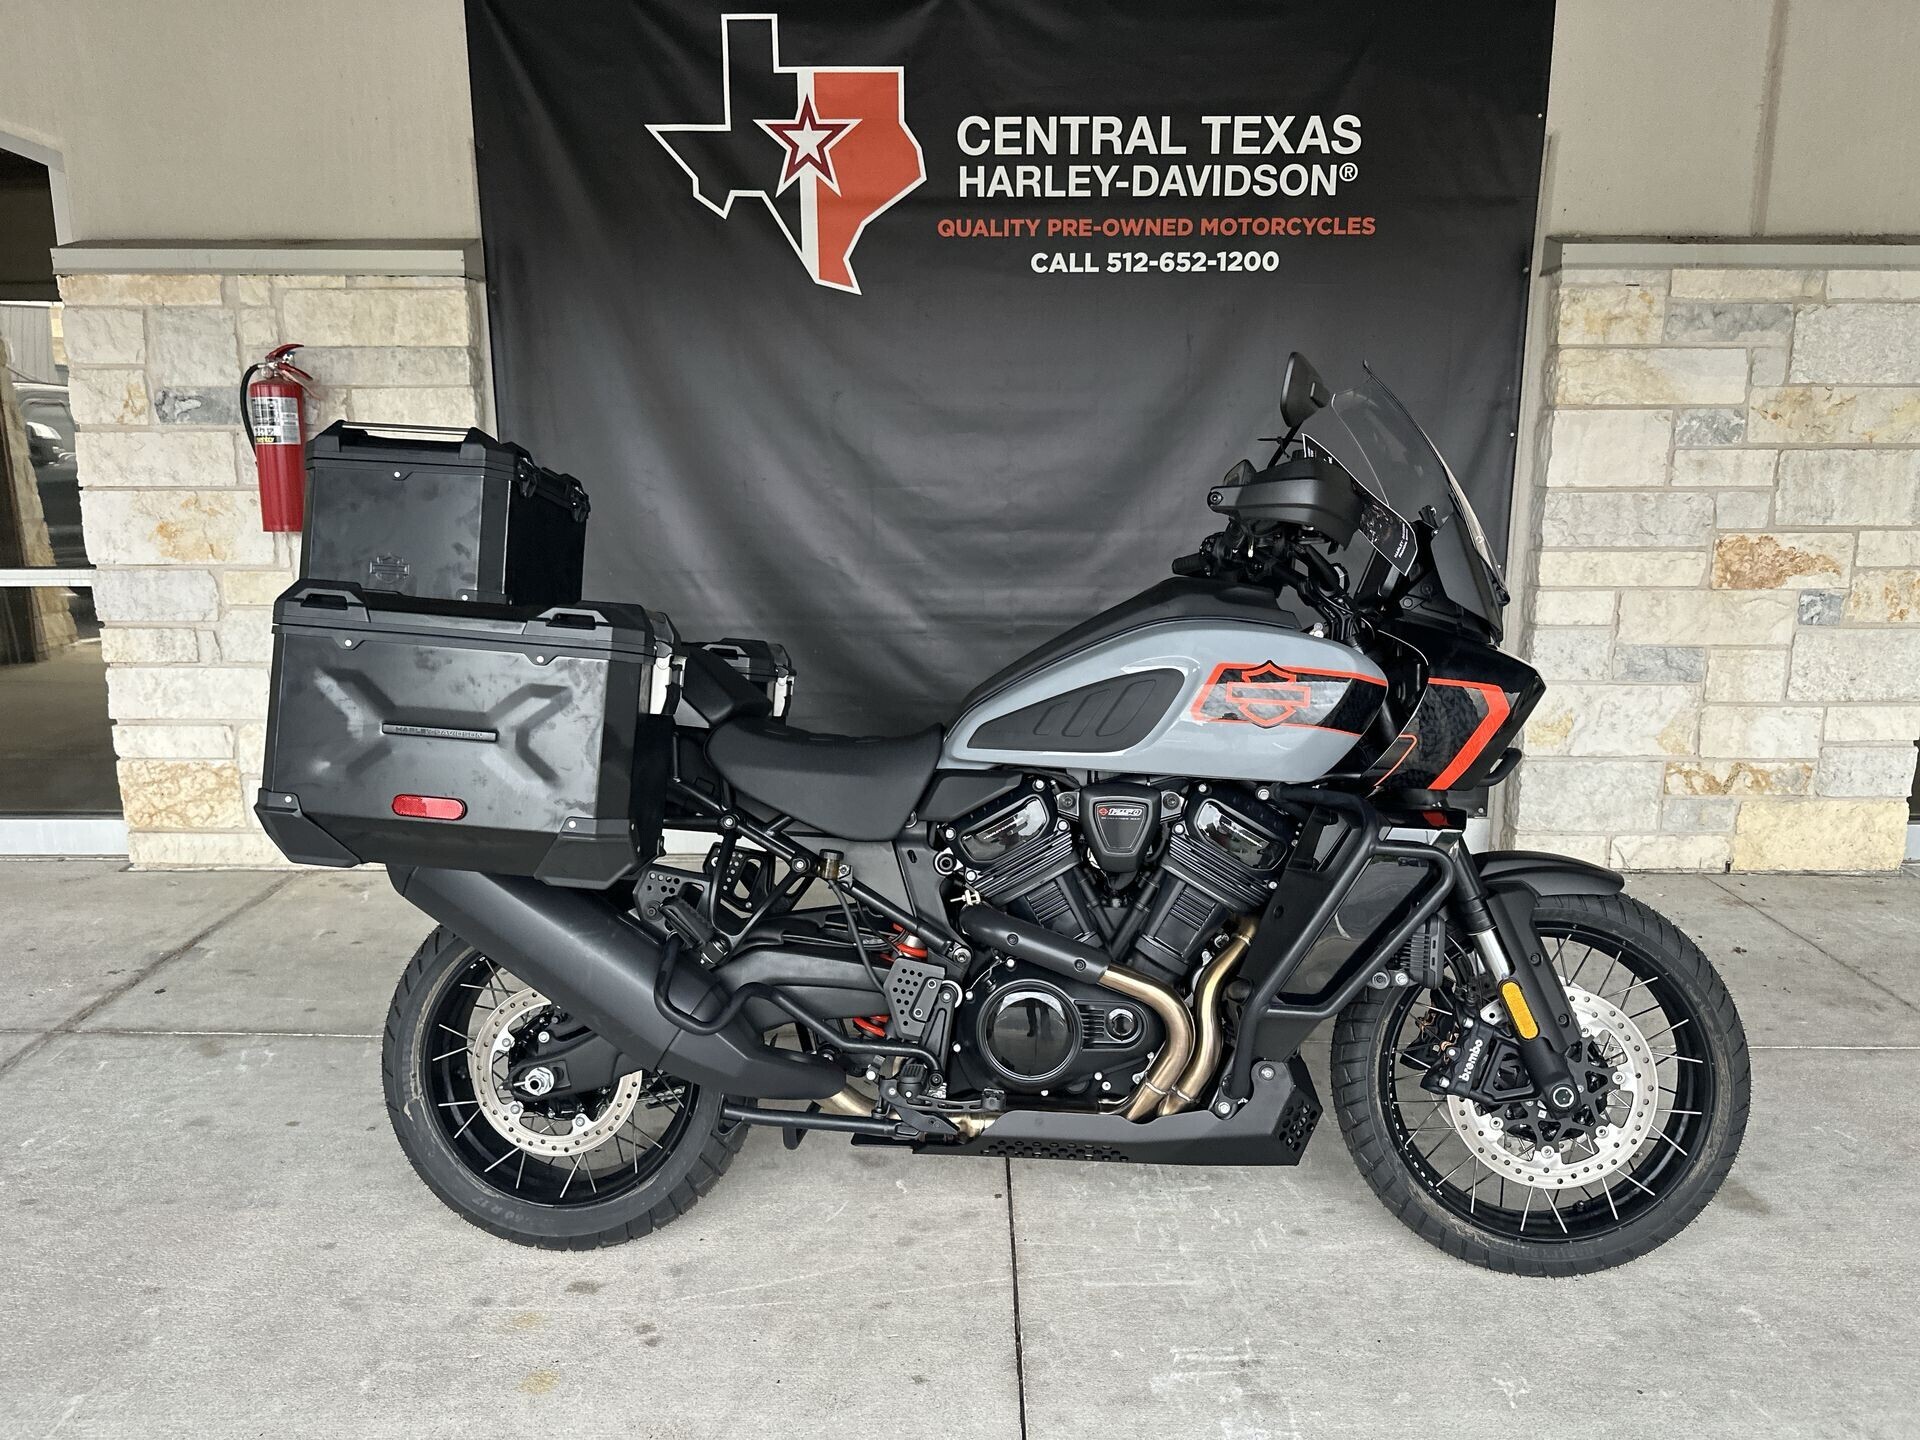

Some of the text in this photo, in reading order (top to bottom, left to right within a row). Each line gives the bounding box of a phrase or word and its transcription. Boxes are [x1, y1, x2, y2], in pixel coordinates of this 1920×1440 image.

[956, 114, 1362, 156] CENTRAL TEXAS
[937, 216, 1376, 238] QUALITY PRE-OWNED MOTORCYCLES
[1030, 250, 1280, 273] CALL 512-652-1200
[1458, 1039, 1484, 1082] brembo
